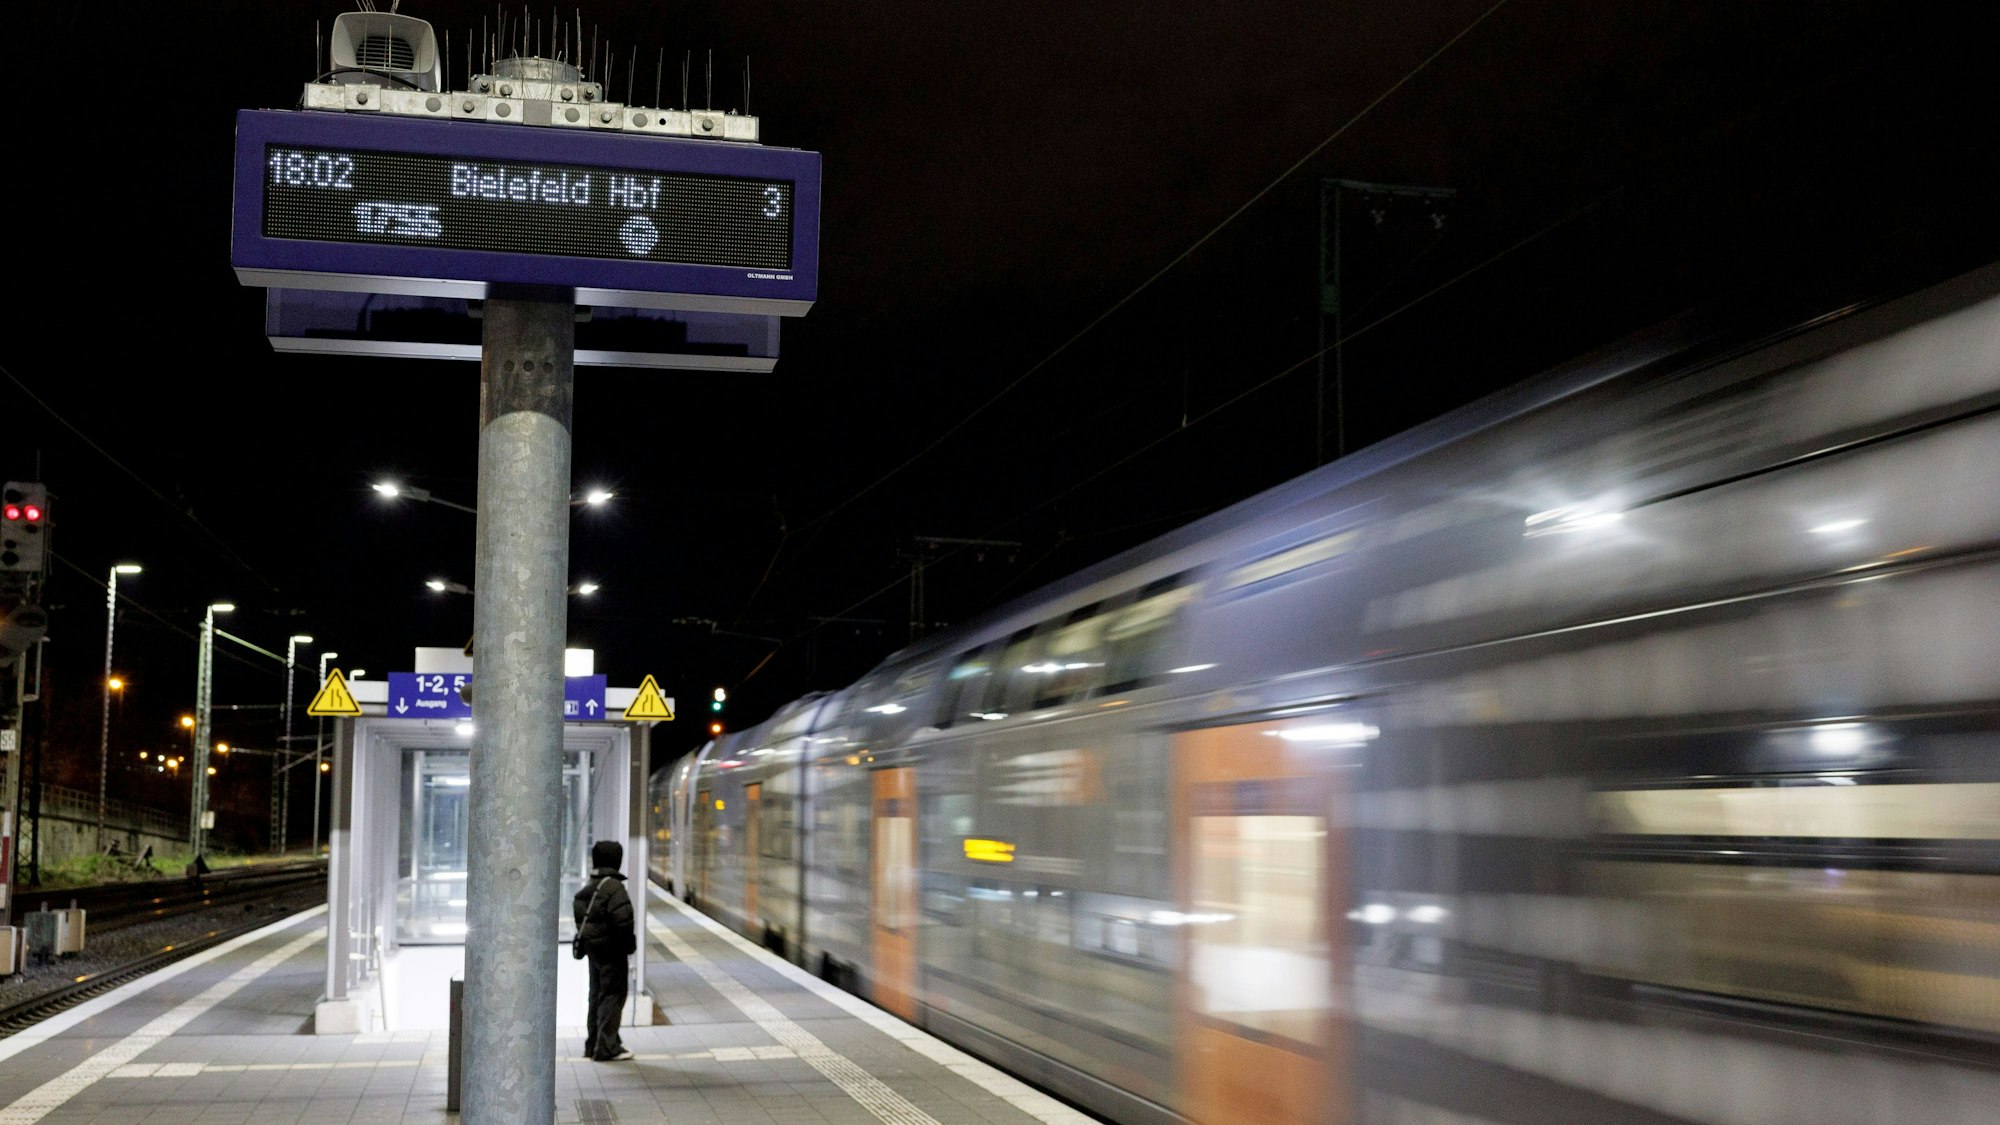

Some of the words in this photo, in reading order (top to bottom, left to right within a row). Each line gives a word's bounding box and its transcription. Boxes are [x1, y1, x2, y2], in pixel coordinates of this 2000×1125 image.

[269, 152, 353, 188] 18:02
[452, 164, 589, 205] Bielefeld
[609, 175, 661, 209] Hbf
[763, 186, 782, 217] 3
[415, 675, 449, 696] 1-2,
[453, 675, 466, 693] 5
[415, 698, 448, 709] Ausgang
